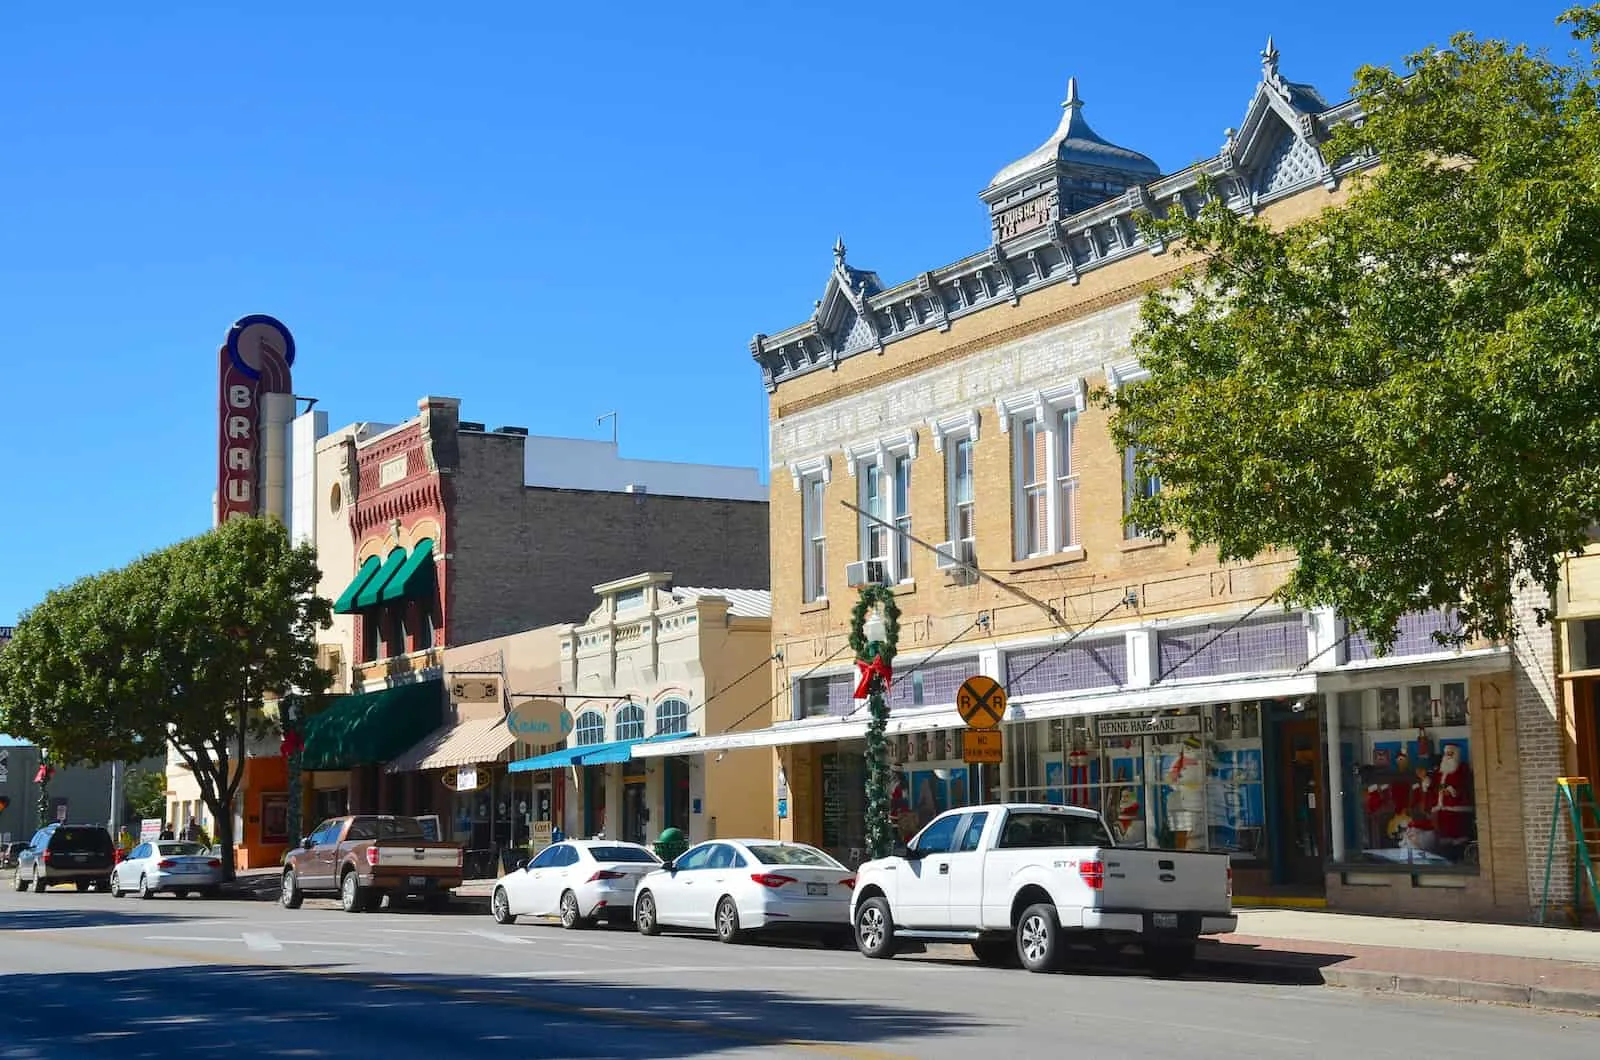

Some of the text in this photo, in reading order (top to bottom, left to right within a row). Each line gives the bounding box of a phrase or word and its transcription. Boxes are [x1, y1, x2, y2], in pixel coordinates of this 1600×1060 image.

[228, 384, 251, 519] BRAU
[1101, 720, 1131, 735] HENNE
[1053, 860, 1077, 868] STX
